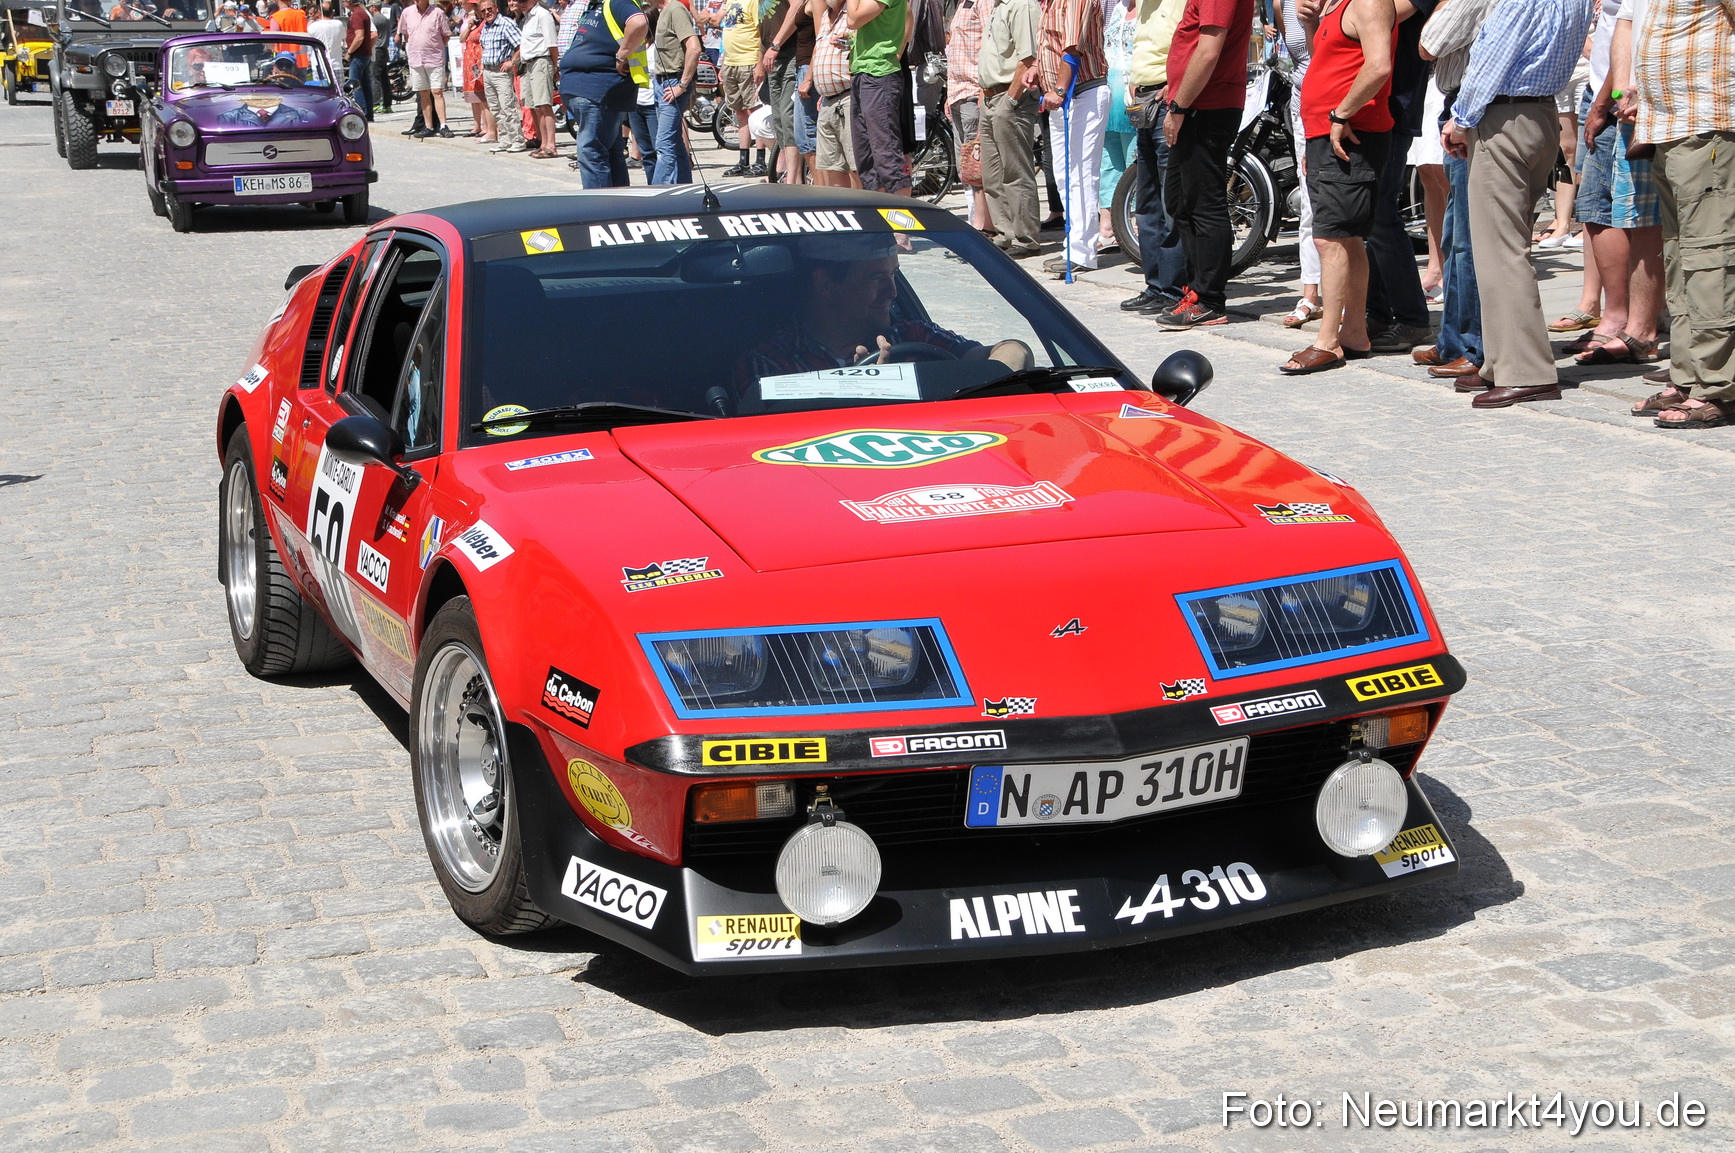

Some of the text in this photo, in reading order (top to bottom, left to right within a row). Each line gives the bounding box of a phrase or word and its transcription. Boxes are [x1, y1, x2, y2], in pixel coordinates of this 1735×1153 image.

[243, 178, 264, 190] KEH
[271, 177, 286, 190] MS
[289, 176, 302, 189] 86
[588, 210, 863, 247] ALPINE RENAULT
[829, 368, 880, 377] 420
[1087, 381, 1117, 389] DEKRA
[529, 450, 585, 464] SOLEX
[778, 433, 974, 464] YACCO
[863, 489, 1055, 521] RALLYE MONTE-CARLO
[929, 492, 965, 501] 58
[1293, 515, 1350, 523] MARCHAL
[361, 544, 388, 587] YACCO
[654, 571, 719, 587] MARCHAL
[546, 675, 594, 714] de Carbon
[1244, 693, 1319, 717] FACOM
[909, 734, 1000, 751] FACOM
[977, 802, 989, 815] D
[1000, 773, 1032, 819] N
[1062, 770, 1124, 816] AP
[1135, 746, 1244, 807] 310H
[580, 783, 617, 809] CIBIE
[1389, 827, 1438, 853] RENAULT
[1401, 843, 1445, 870] sport
[573, 862, 657, 920] YACCO
[726, 916, 795, 935] RENAULT
[950, 889, 1086, 940] ALPINE
[726, 934, 797, 955] sport
